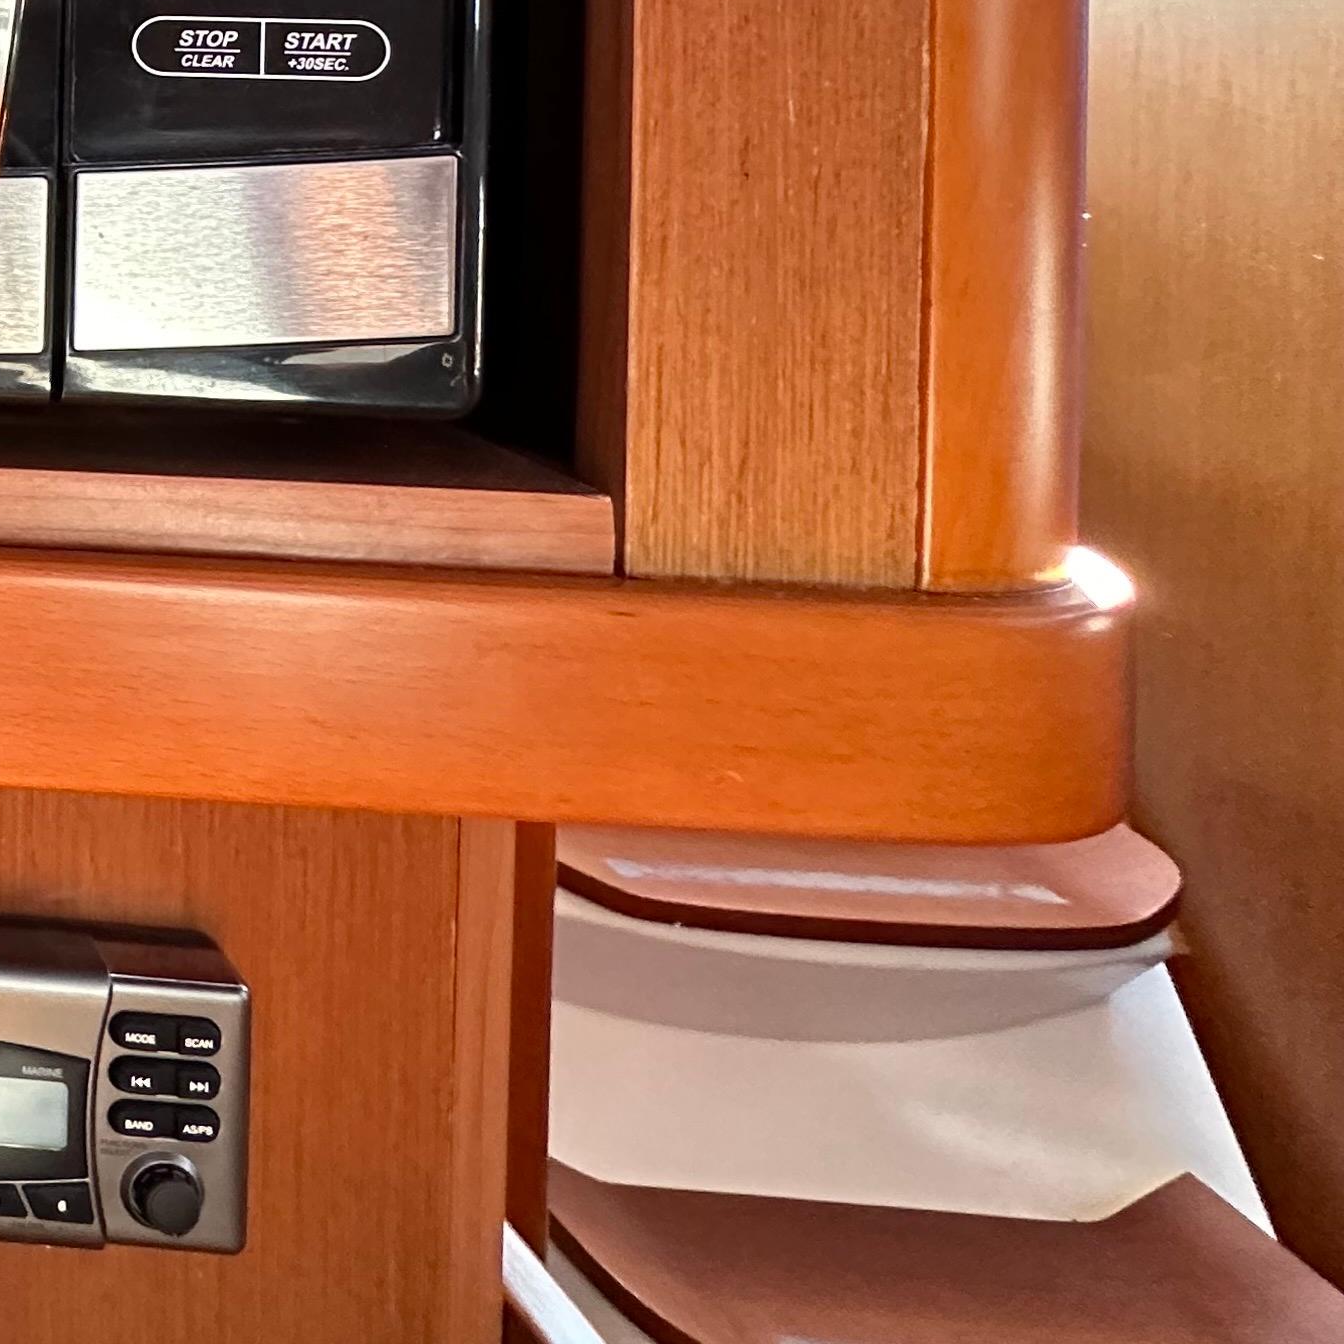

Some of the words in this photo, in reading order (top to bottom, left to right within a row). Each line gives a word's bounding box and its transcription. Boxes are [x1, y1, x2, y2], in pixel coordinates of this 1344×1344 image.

[178, 29, 239, 48] STOP
[284, 32, 357, 51] START
[180, 54, 235, 69] CLEAR
[287, 57, 350, 72] +30SEC.
[124, 1032, 157, 1046] MODE
[184, 1037, 214, 1050] SCAN
[22, 1065, 64, 1079] MARINE
[124, 1119, 154, 1132] BAND
[57, 1199, 67, 1213] 6
